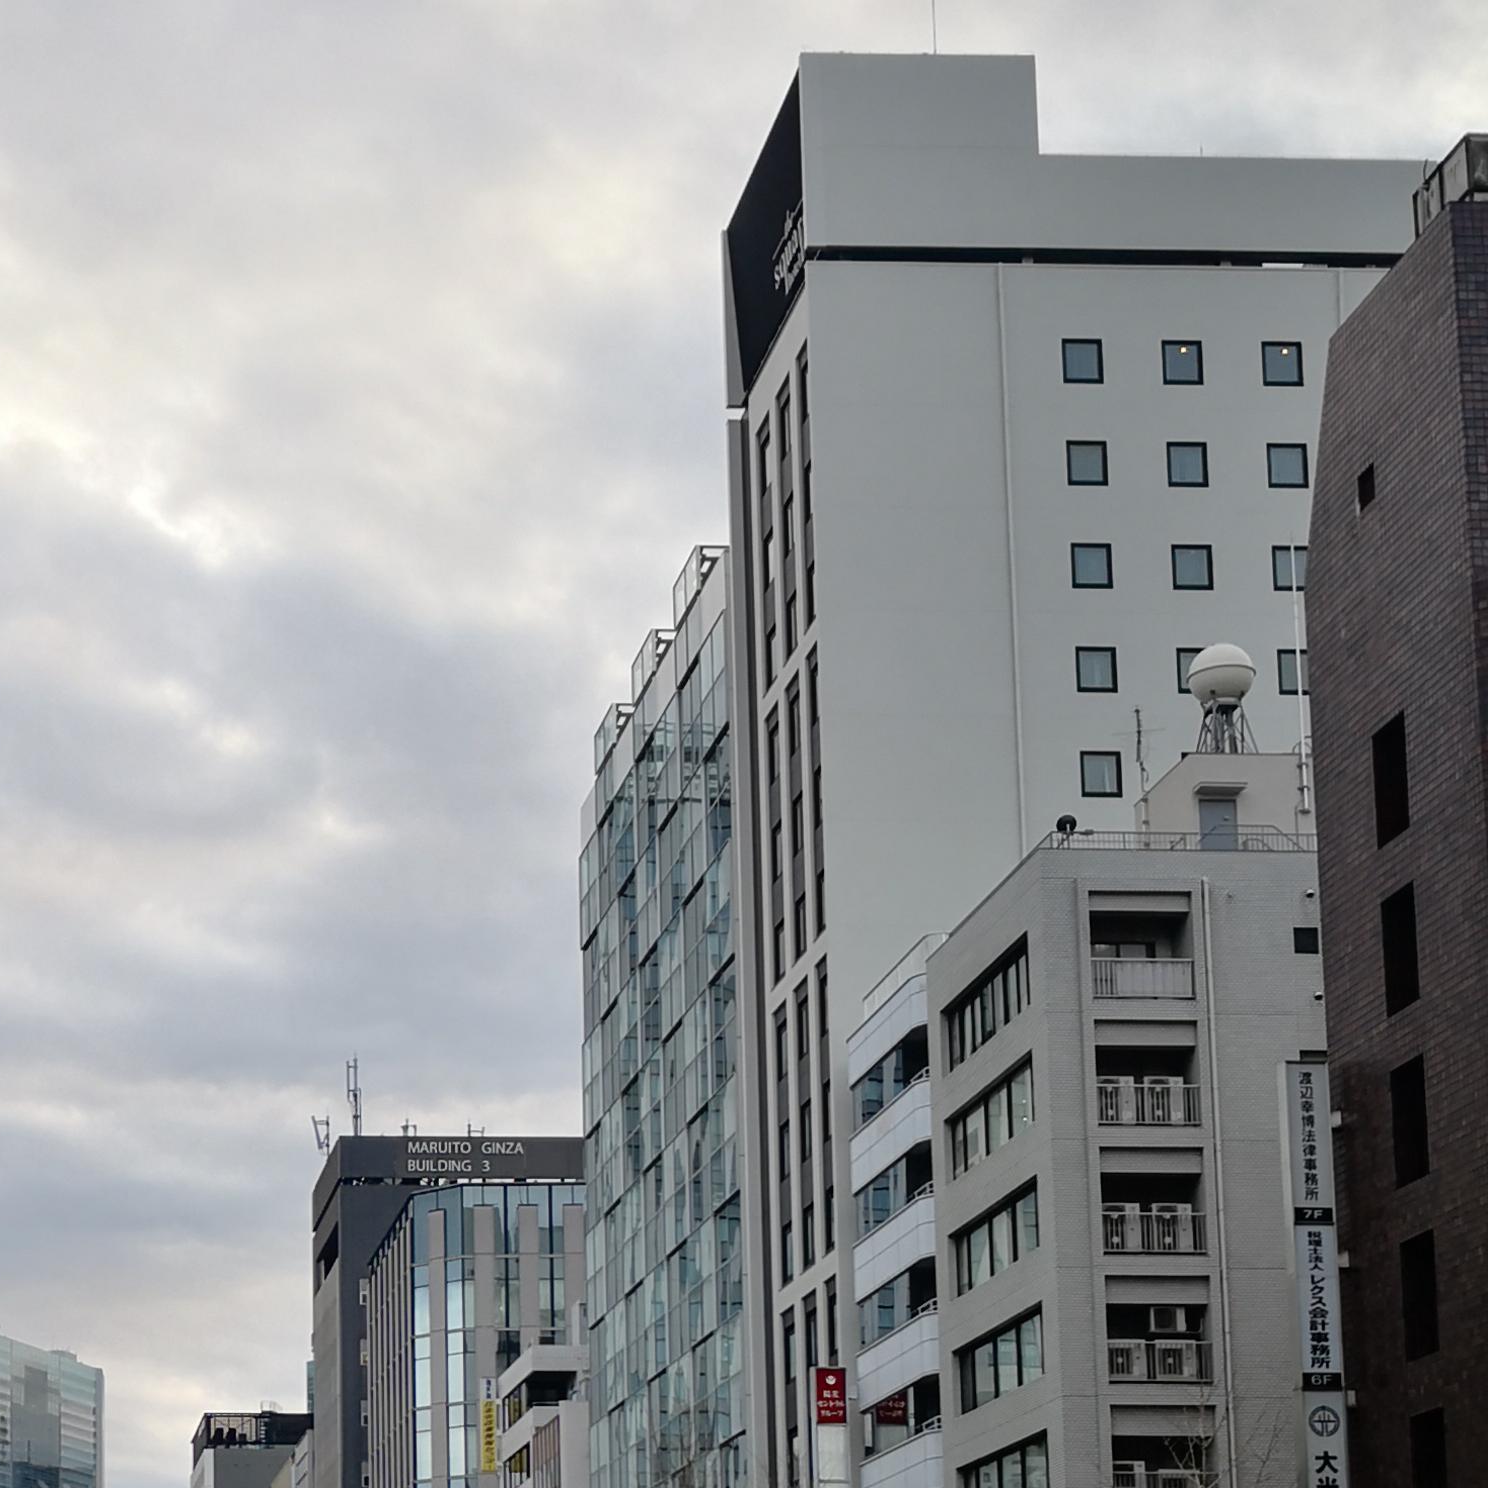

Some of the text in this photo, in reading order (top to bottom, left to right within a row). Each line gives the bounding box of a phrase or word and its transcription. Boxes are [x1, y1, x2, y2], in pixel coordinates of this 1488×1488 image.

[407, 1141, 524, 1155] MARUITO GINZA
[407, 1159, 491, 1172] BUILDING 3
[1303, 1210, 1323, 1220] 7F
[1311, 1374, 1333, 1386] 6F
